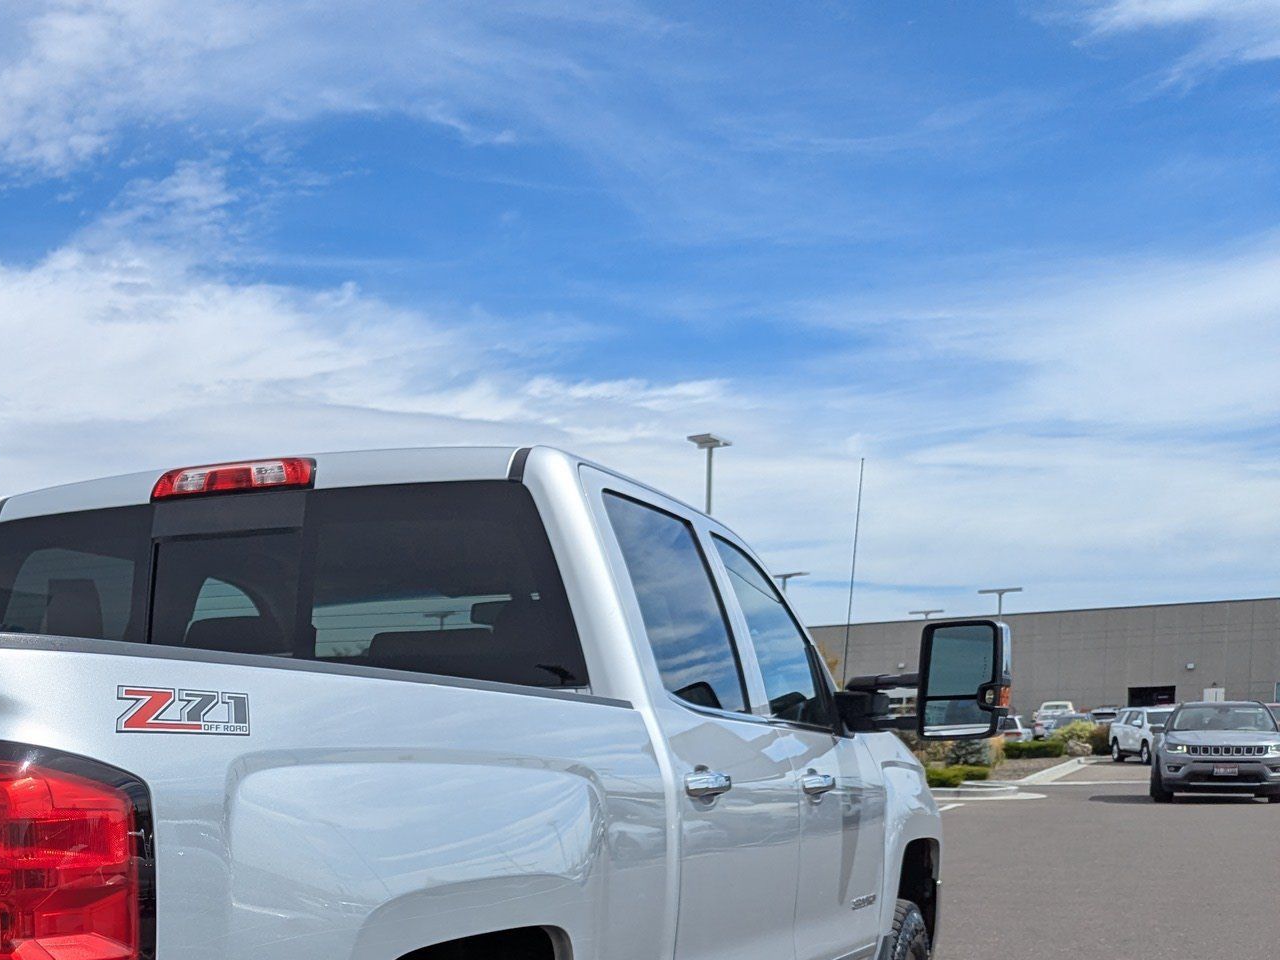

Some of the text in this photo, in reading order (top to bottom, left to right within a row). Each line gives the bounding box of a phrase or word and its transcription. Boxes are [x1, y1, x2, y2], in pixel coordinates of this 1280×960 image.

[115, 685, 250, 736] Z71
[203, 724, 248, 733] OFF ROAD
